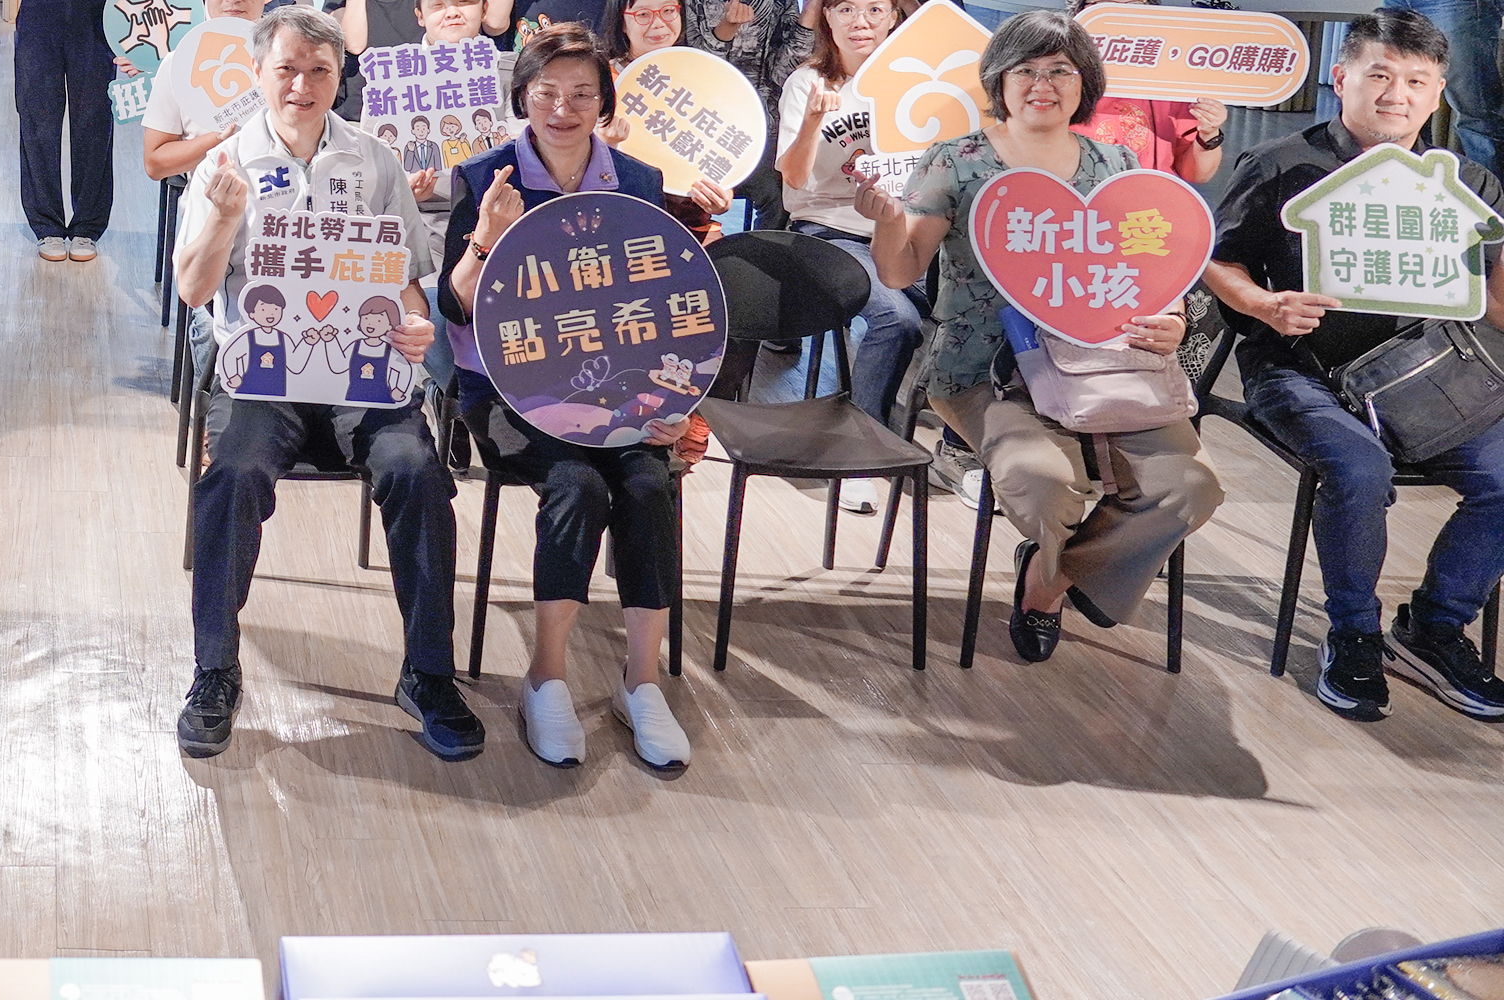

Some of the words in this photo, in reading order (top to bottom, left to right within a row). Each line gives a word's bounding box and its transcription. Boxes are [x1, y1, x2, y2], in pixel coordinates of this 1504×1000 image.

[363, 39, 494, 81] 行動支持
[214, 86, 264, 124] 新北市庇護
[366, 77, 499, 118] 新北庇護
[635, 62, 754, 160] 新北庇護
[620, 91, 734, 185] 中秋獻禮
[876, 180, 904, 193] mile
[262, 213, 402, 246] 新北勞工局
[1005, 207, 1173, 257] 新北愛
[1329, 202, 1459, 243] 群星圍繞
[250, 244, 408, 286] 攜手庇護
[517, 233, 672, 299] 小衛星
[1032, 263, 1141, 309] 小孩
[1330, 247, 1460, 289] 守護兒少
[498, 289, 715, 366] 點亮希望
